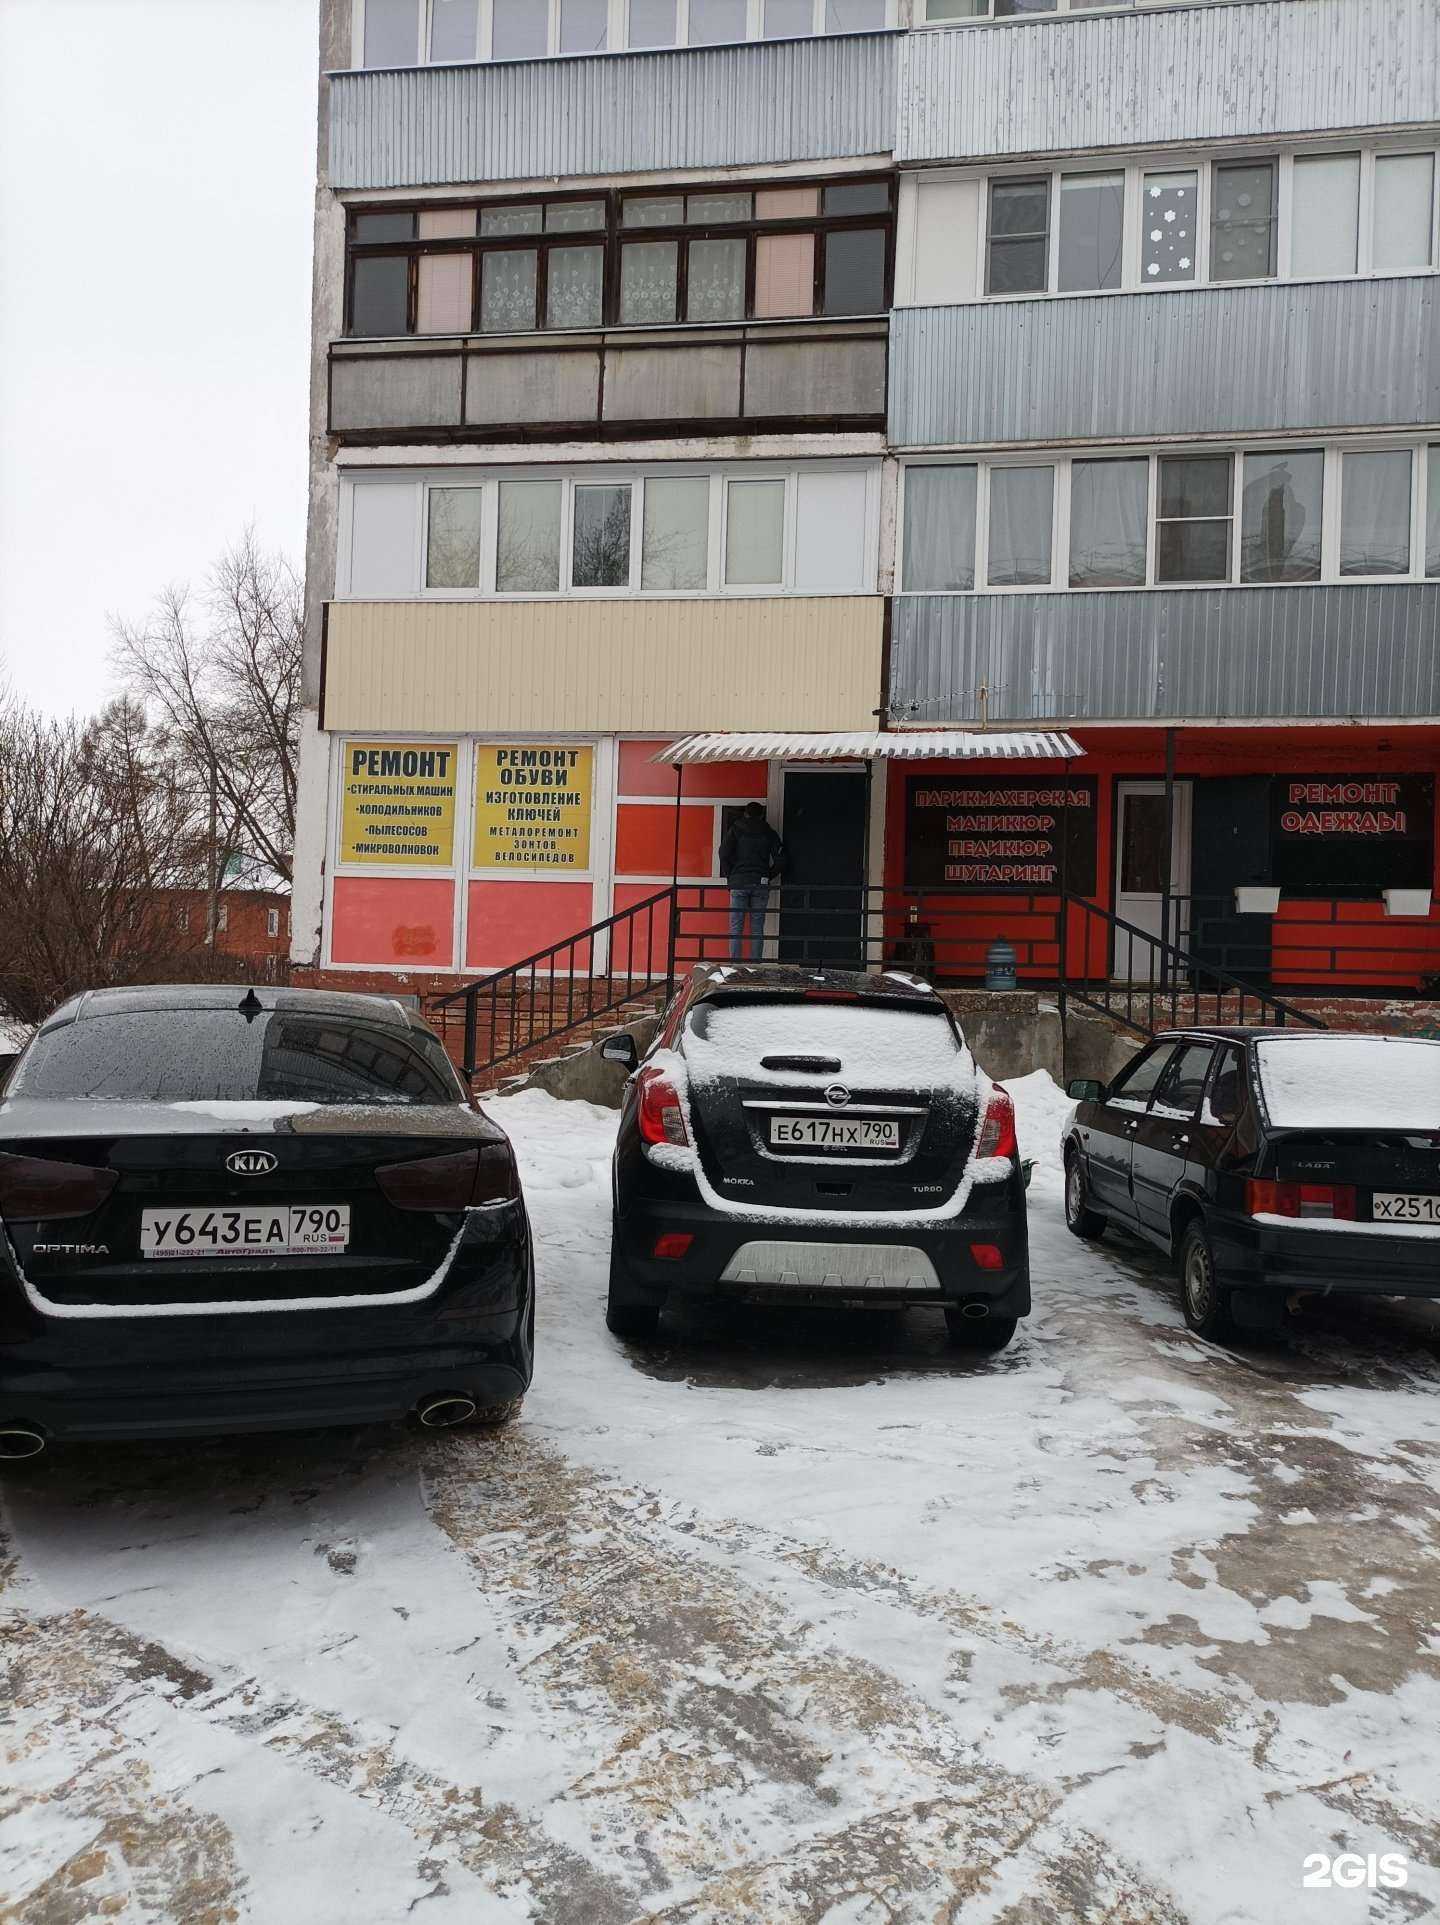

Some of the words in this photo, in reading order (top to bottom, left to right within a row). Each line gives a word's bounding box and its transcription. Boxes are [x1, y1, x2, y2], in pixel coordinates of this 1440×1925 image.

[352, 750, 451, 778] РЕМОНТ
[496, 750, 579, 767] РЕМОНТ
[500, 768, 568, 786] ОБУВИ
[350, 784, 414, 796] СТИРАЛЬНЫХ
[416, 786, 453, 797] МАШИН
[486, 791, 581, 806] ИЗГОТОВЛЕНИЕ
[1289, 783, 1400, 805] РЕМОНТ
[915, 790, 1091, 808] ПАРИКМАХЕРСКАЯ
[359, 804, 442, 817] ХОЛОДИЛЬНИКОВ
[507, 806, 561, 822] КЛЮЧЕЙ
[946, 815, 1056, 833] МАНИКЮР
[1281, 811, 1407, 834] ОДЕЖДЫ
[368, 825, 428, 837] ПЫЛЕСОСОВ
[489, 826, 579, 839] МЕТАЛОРЕМОНТ
[355, 843, 439, 856] МИКРОВОЛНОВОК
[513, 839, 557, 850] ЗОНТОВ
[948, 839, 1053, 858] ПЕДИКЮР
[494, 851, 575, 864] ВЕЛОСИПЕДОВ
[944, 864, 1058, 883] ШУГАРИНГ
[777, 1121, 858, 1144] Е617НХ
[862, 1122, 893, 1139] 790
[234, 1154, 270, 1171] KIA
[912, 1185, 943, 1193] TURBO
[153, 1211, 285, 1246] У643ЕА
[291, 1209, 341, 1234] 790
[303, 1233, 327, 1243] RUS
[32, 1243, 110, 1255] OPTIMA
